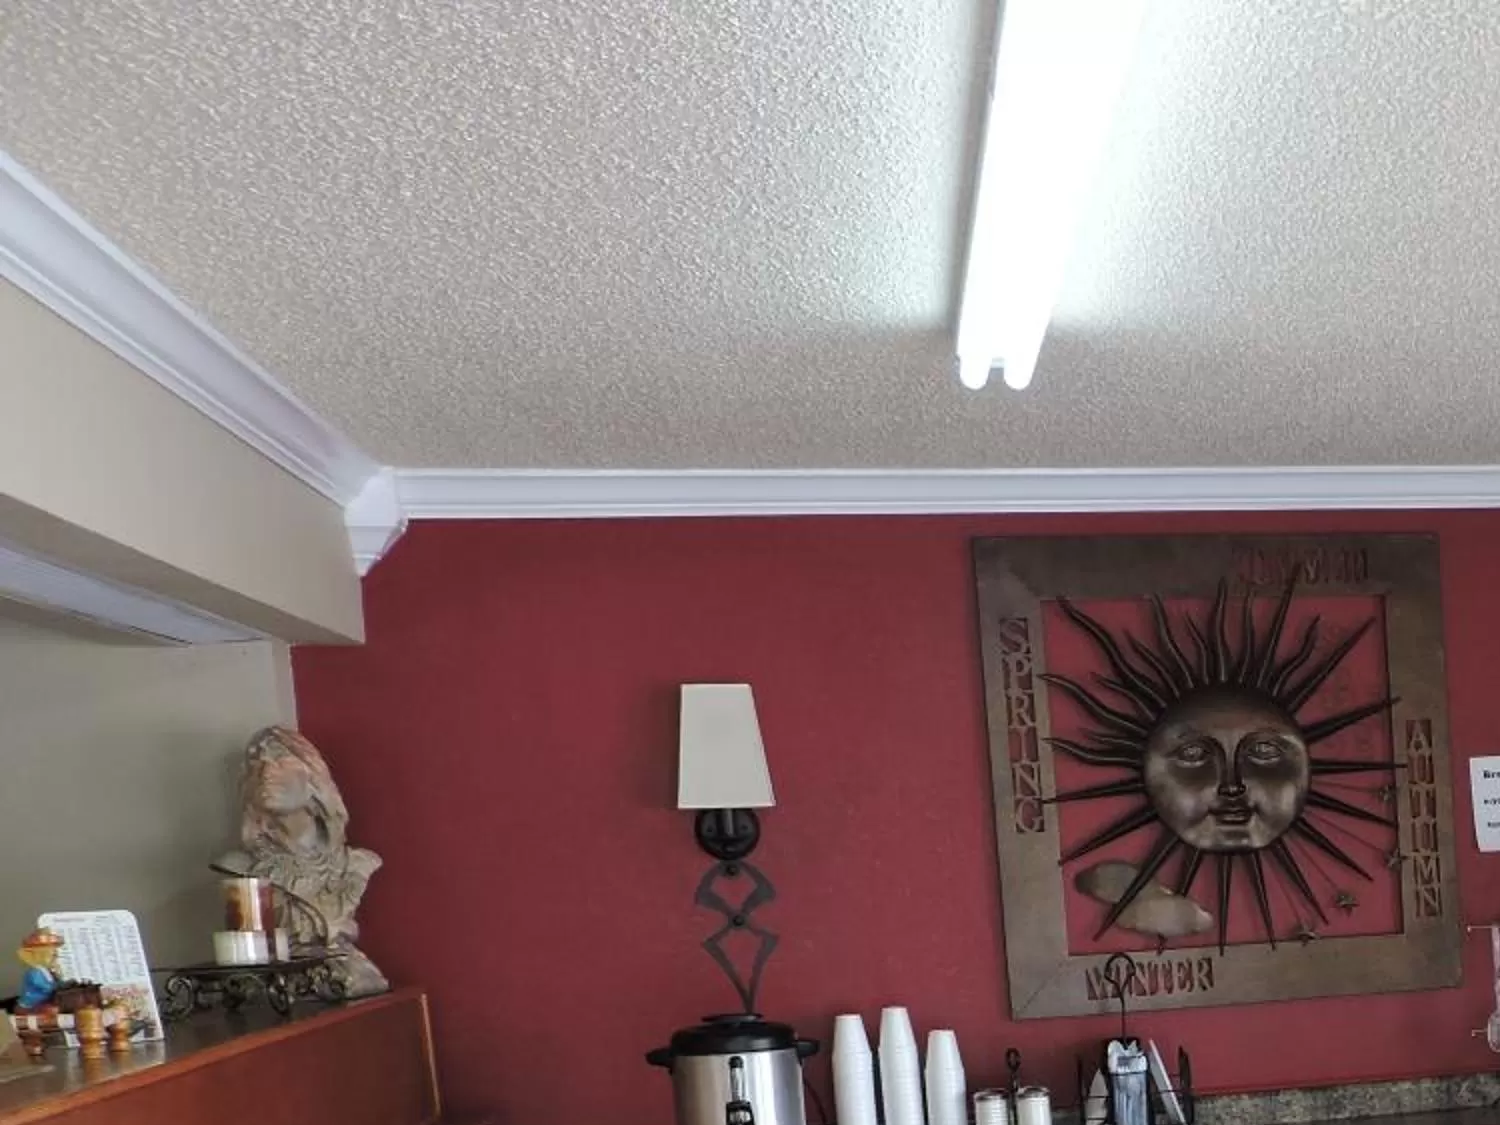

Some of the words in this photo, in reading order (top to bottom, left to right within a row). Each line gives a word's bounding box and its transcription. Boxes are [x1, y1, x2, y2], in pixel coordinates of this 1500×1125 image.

[1000, 617, 1045, 833] SPRING
[1405, 719, 1443, 918] AUTUMN
[1085, 957, 1214, 1000] WINTER
